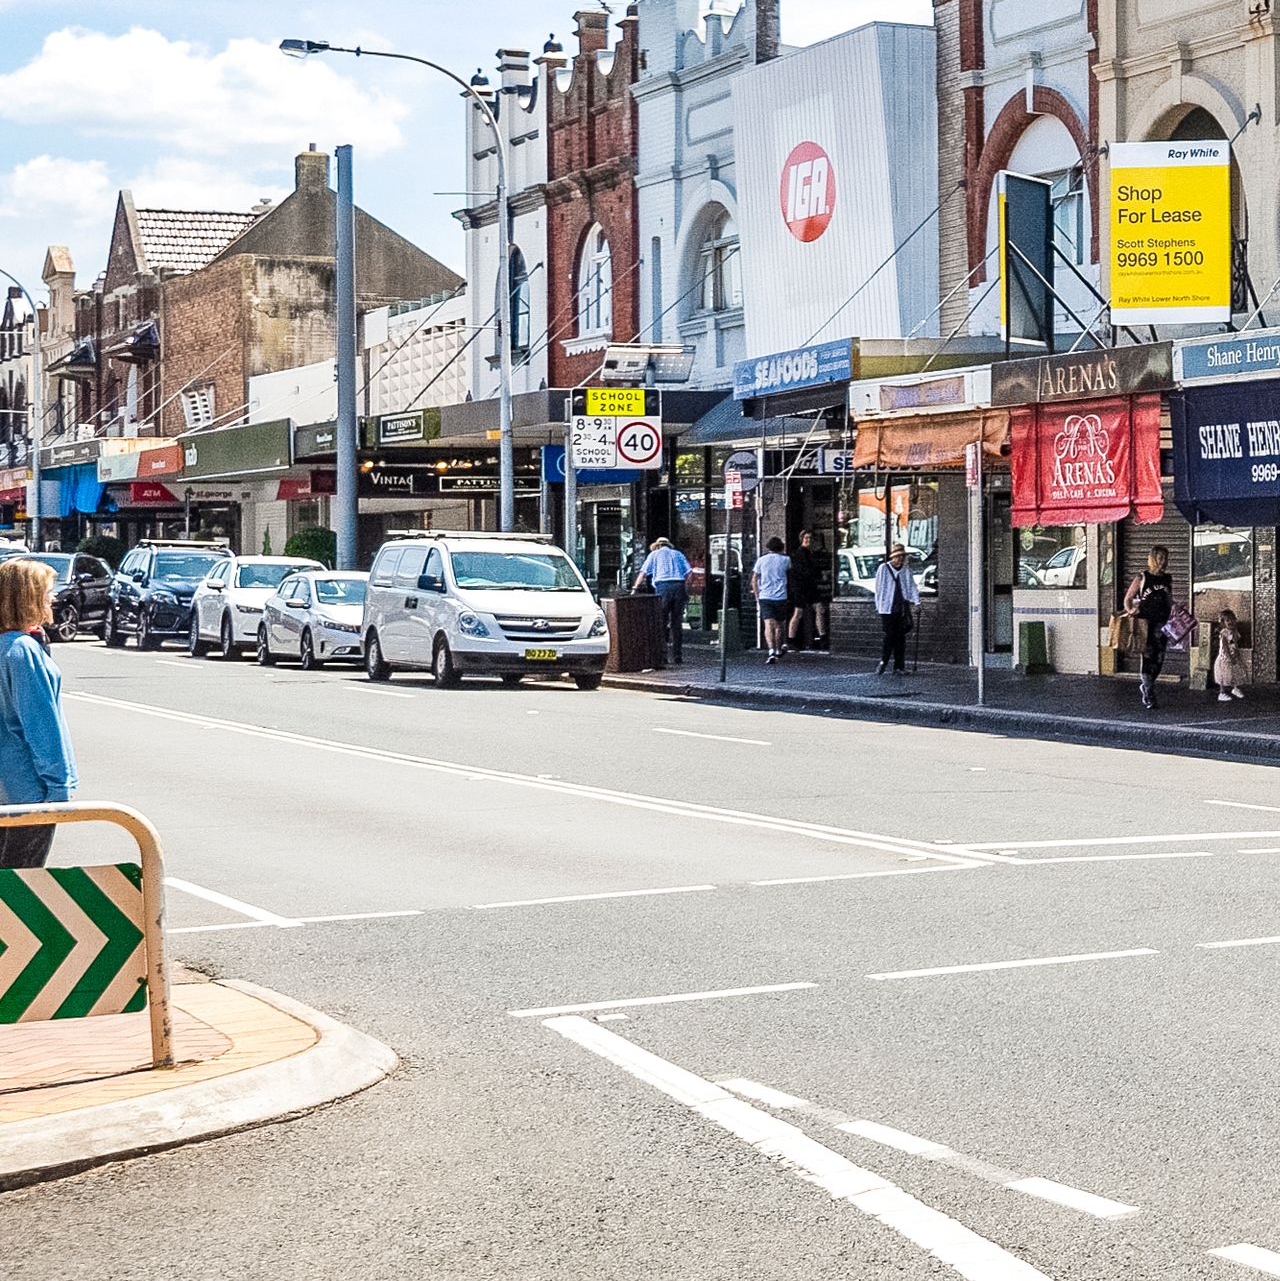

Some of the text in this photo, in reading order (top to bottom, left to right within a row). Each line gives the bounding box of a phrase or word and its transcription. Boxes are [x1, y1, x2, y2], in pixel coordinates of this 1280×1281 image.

[1168, 148, 1219, 159] Ray White
[787, 157, 828, 223] IGA
[1117, 186, 1162, 203] Shop
[1118, 209, 1202, 224] For Lease
[1117, 238, 1195, 249] Scott Stephens
[1117, 251, 1203, 268] 9969 1500
[1152, 295, 1171, 303] Lower
[1207, 345, 1242, 368] Shane
[755, 350, 818, 390] SEAFOODS
[1040, 354, 1117, 396] ARENA'S
[592, 392, 641, 401] SCHOOL
[600, 404, 633, 412] ZONE
[624, 434, 654, 451] 40
[1199, 423, 1243, 460] SHANE
[577, 448, 611, 456] SCHOOL
[1052, 456, 1116, 492] ARENA'S
[142, 489, 161, 497] ATM
